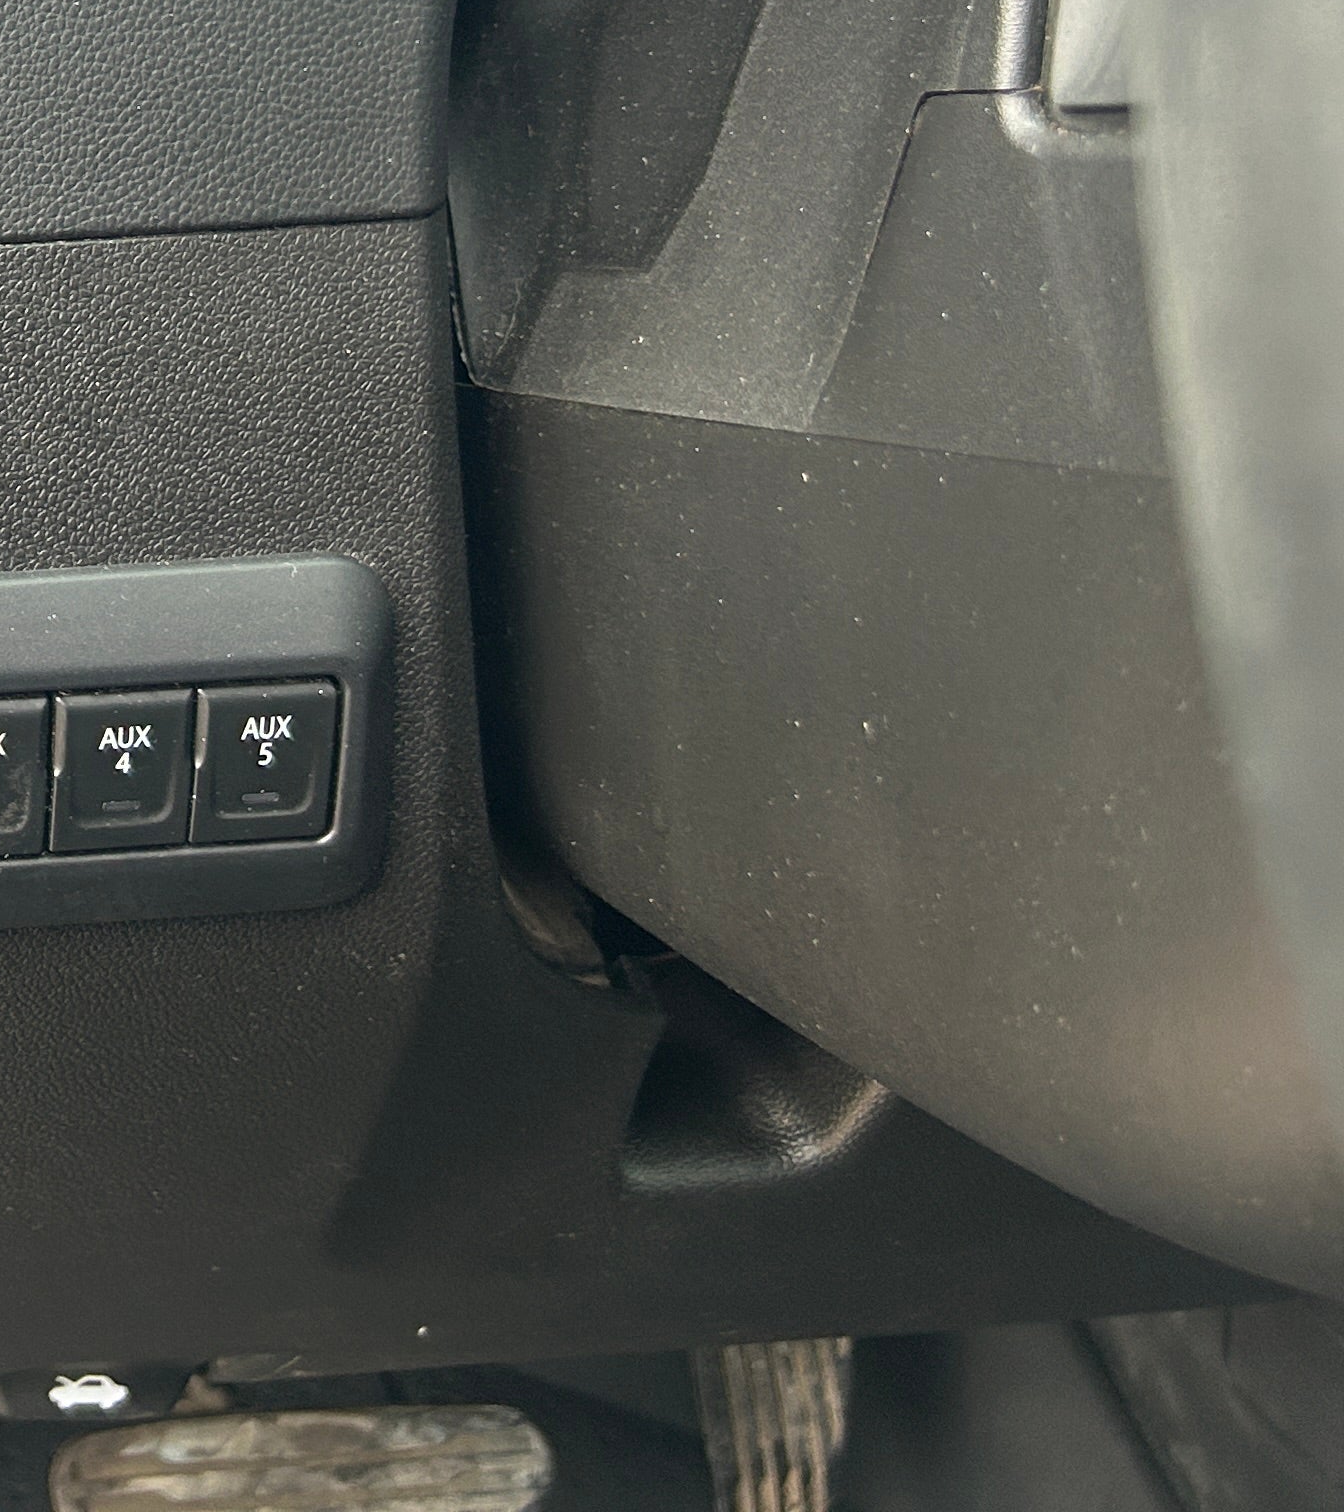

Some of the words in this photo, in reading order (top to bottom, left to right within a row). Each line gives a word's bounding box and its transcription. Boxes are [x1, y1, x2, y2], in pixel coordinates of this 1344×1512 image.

[98, 724, 153, 752] AUX
[240, 714, 294, 742] AUX
[114, 752, 132, 775] 4
[257, 742, 275, 768] 5
